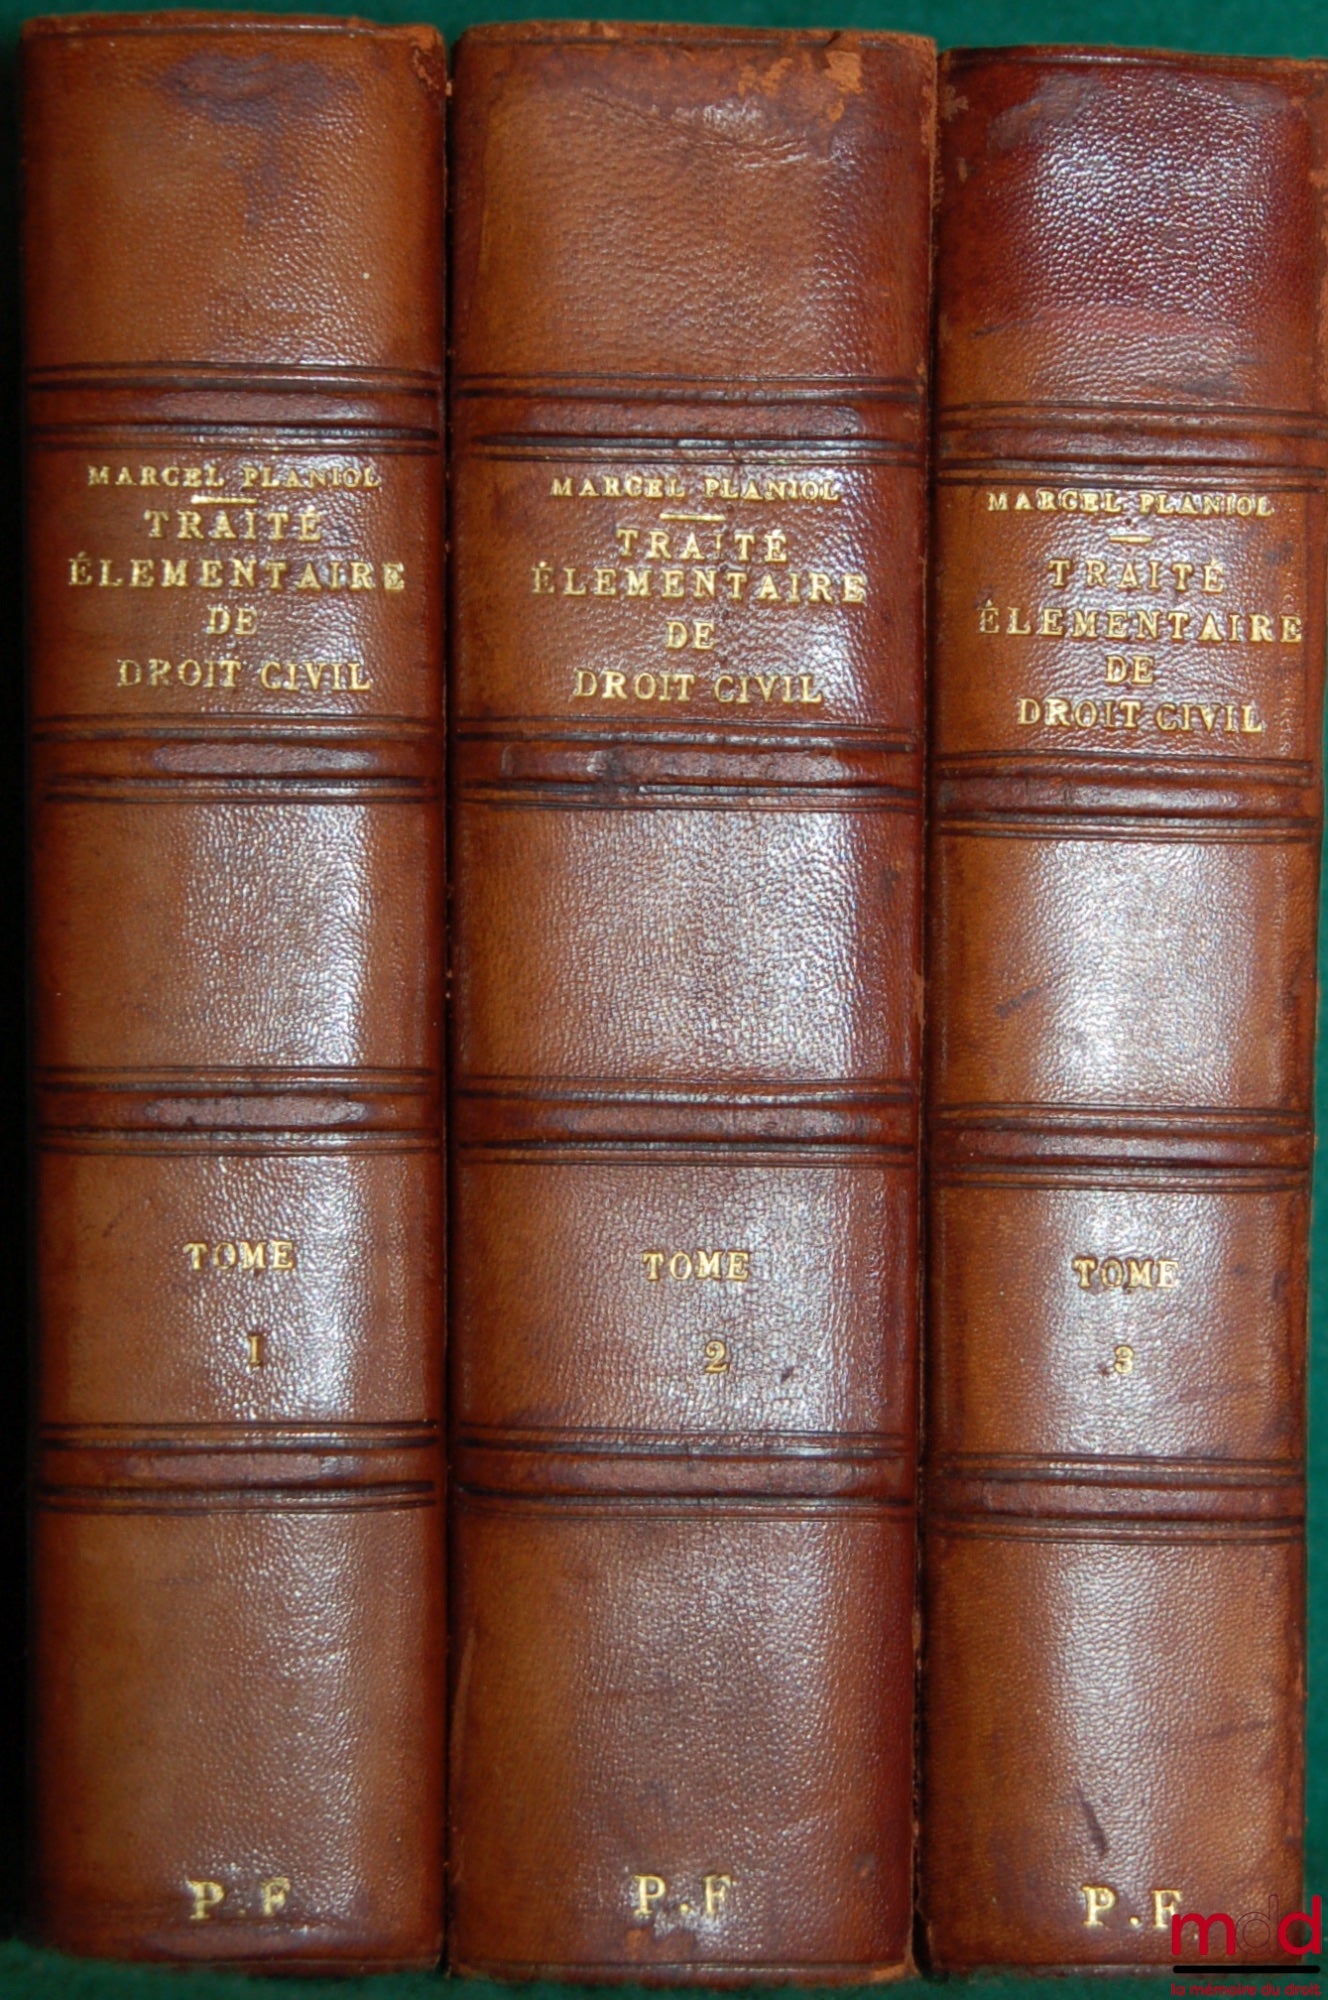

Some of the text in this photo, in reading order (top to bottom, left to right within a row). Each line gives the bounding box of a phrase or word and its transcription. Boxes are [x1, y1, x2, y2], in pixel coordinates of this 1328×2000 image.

[88, 465, 382, 489] MARCEL PLANIOL
[551, 475, 840, 501] MARCEL PLANIOL
[987, 489, 1275, 517] MARCEL PLANIOL
[144, 507, 323, 542] TRAITÉ
[617, 528, 788, 564] TRAITÉ
[68, 551, 405, 592] ÉLEMENTAIRE
[532, 561, 867, 604] ÉLEMENTAIRE
[1049, 559, 1225, 594] TRAITÉ
[206, 606, 258, 636] DE
[666, 620, 716, 650] DE
[979, 599, 1302, 645] ÉLEMENTAIRE
[116, 658, 372, 692] DROIT CIVIL
[573, 667, 822, 704] DROIT CIVIL
[1104, 655, 1156, 685] DE
[1017, 698, 1264, 734] DROIT CIVIL
[182, 1240, 294, 1271] TOME
[642, 1250, 750, 1282] TOME
[1072, 1257, 1182, 1289] TOME
[705, 1340, 729, 1372] 2
[1113, 1345, 1135, 1375] 3
